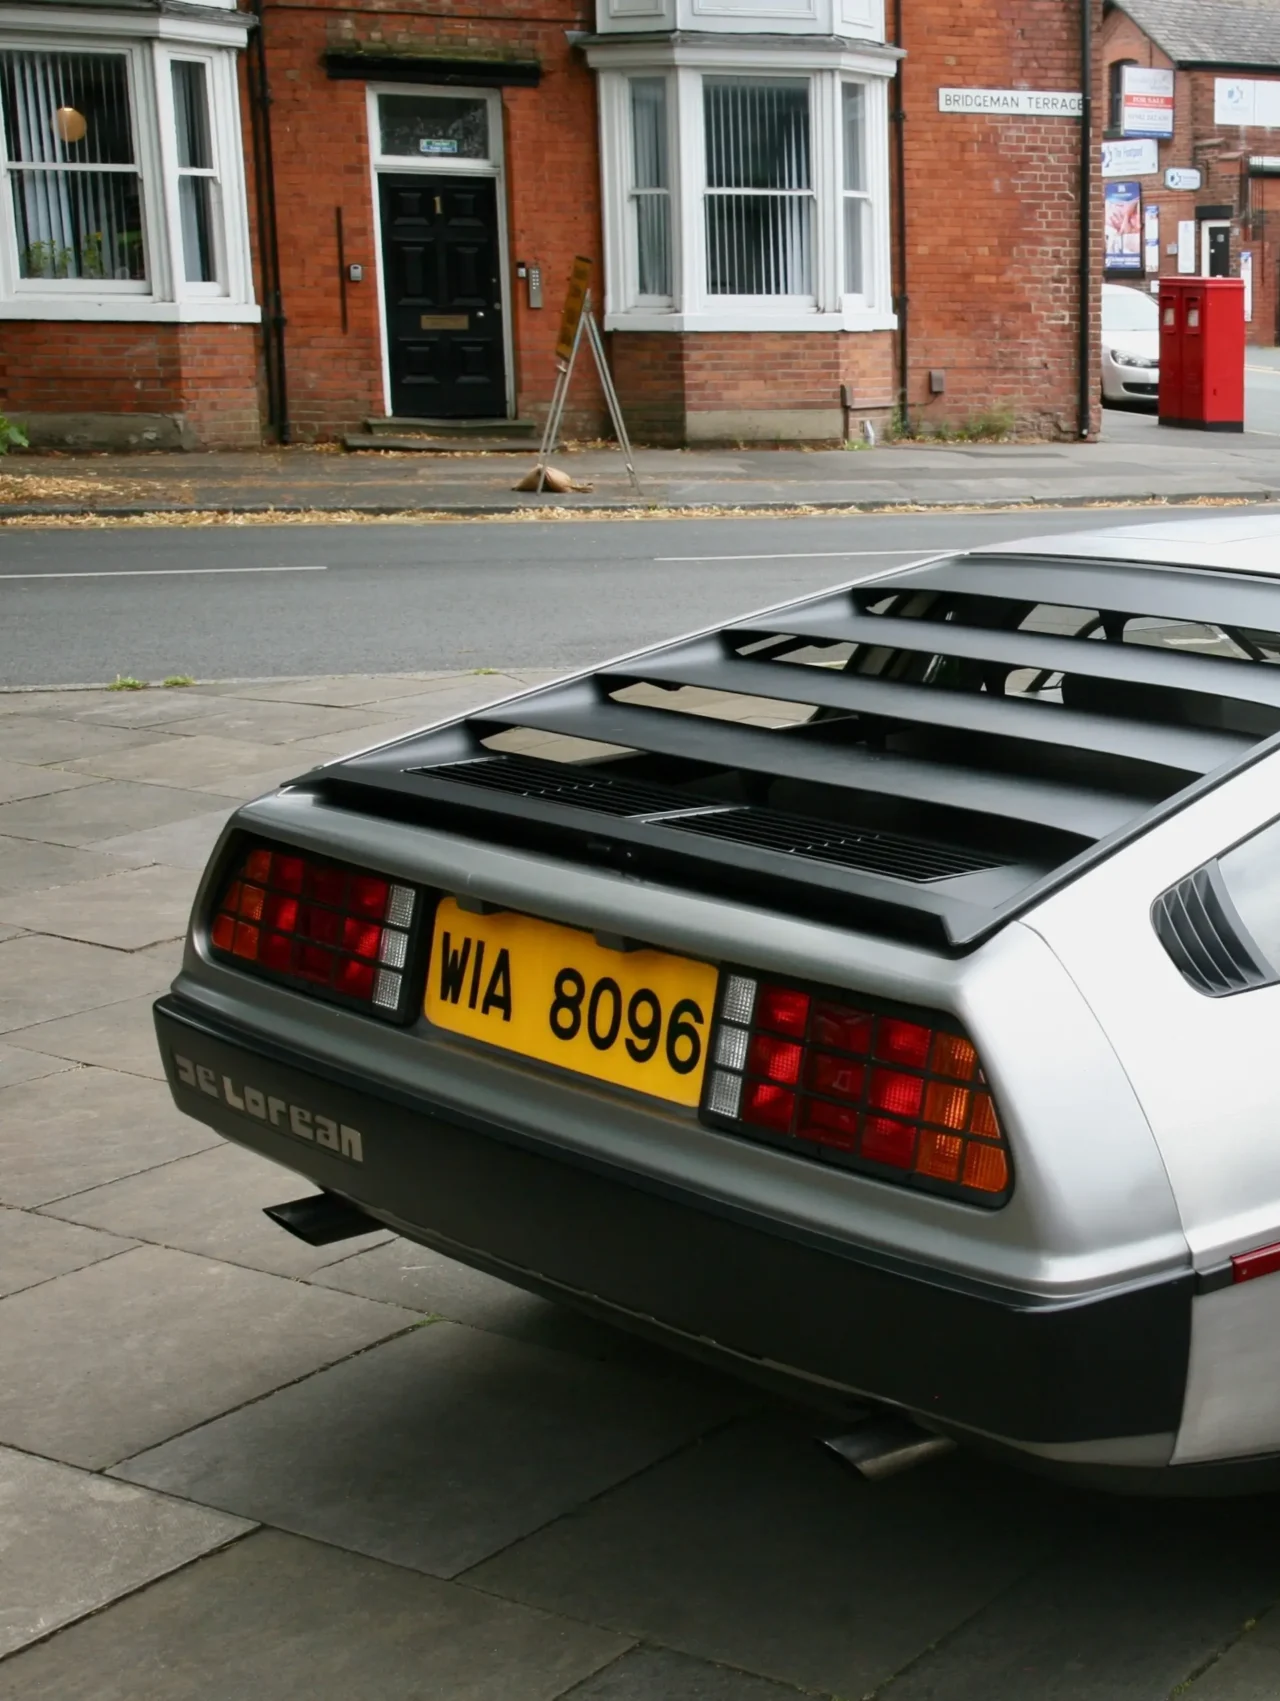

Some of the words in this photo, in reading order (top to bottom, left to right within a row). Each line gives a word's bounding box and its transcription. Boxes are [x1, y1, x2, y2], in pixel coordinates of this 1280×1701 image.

[944, 93, 1019, 109] BRIDGEMAN
[1026, 96, 1083, 111] TERRACE
[439, 931, 512, 1023] WIA
[549, 967, 704, 1075] 8096
